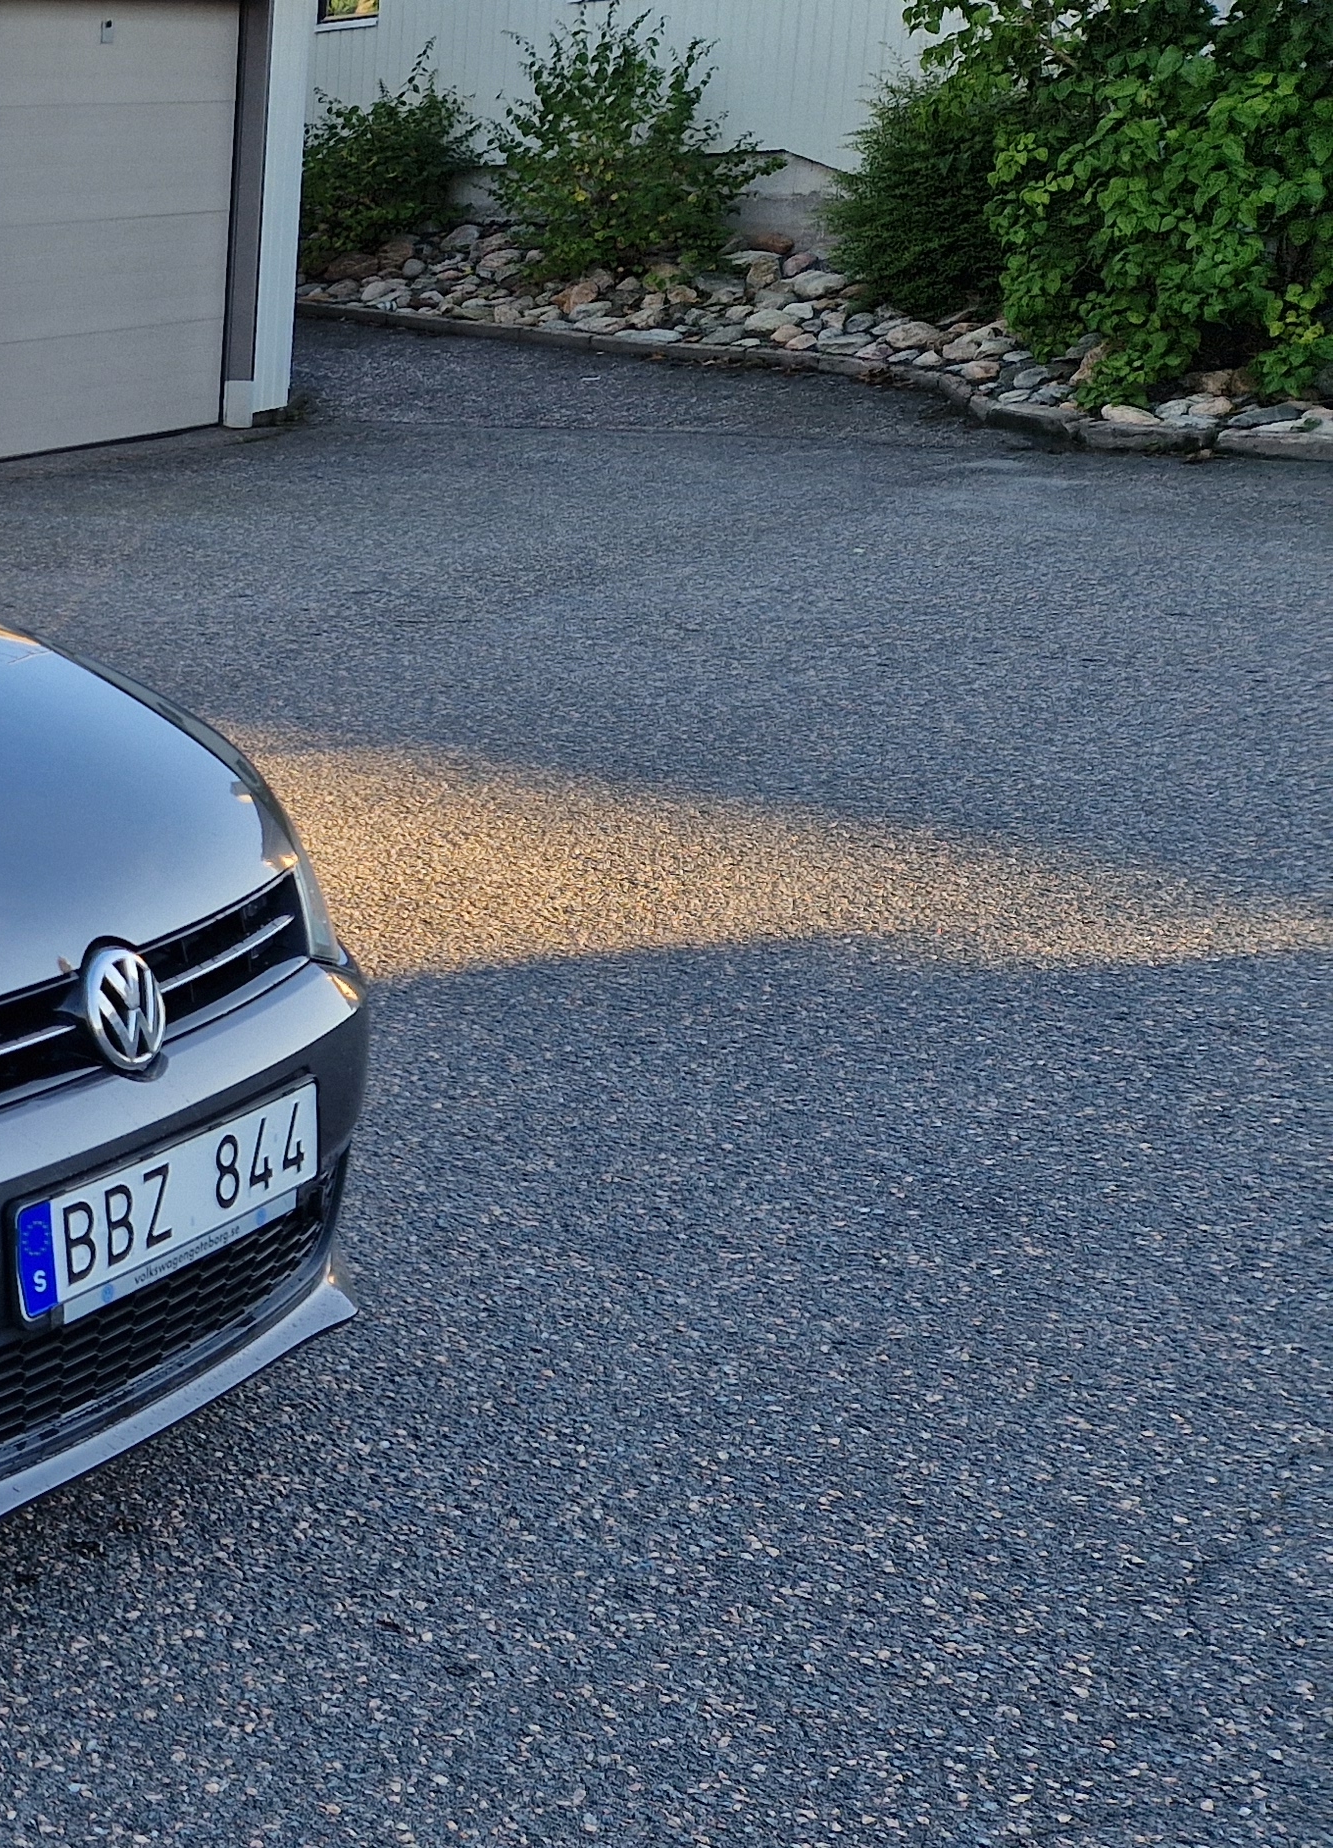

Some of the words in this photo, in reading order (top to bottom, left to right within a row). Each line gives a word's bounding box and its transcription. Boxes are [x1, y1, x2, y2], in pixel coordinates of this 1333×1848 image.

[62, 1162, 173, 1285] BBZ
[214, 1101, 305, 1209] 844
[33, 1270, 47, 1293] S
